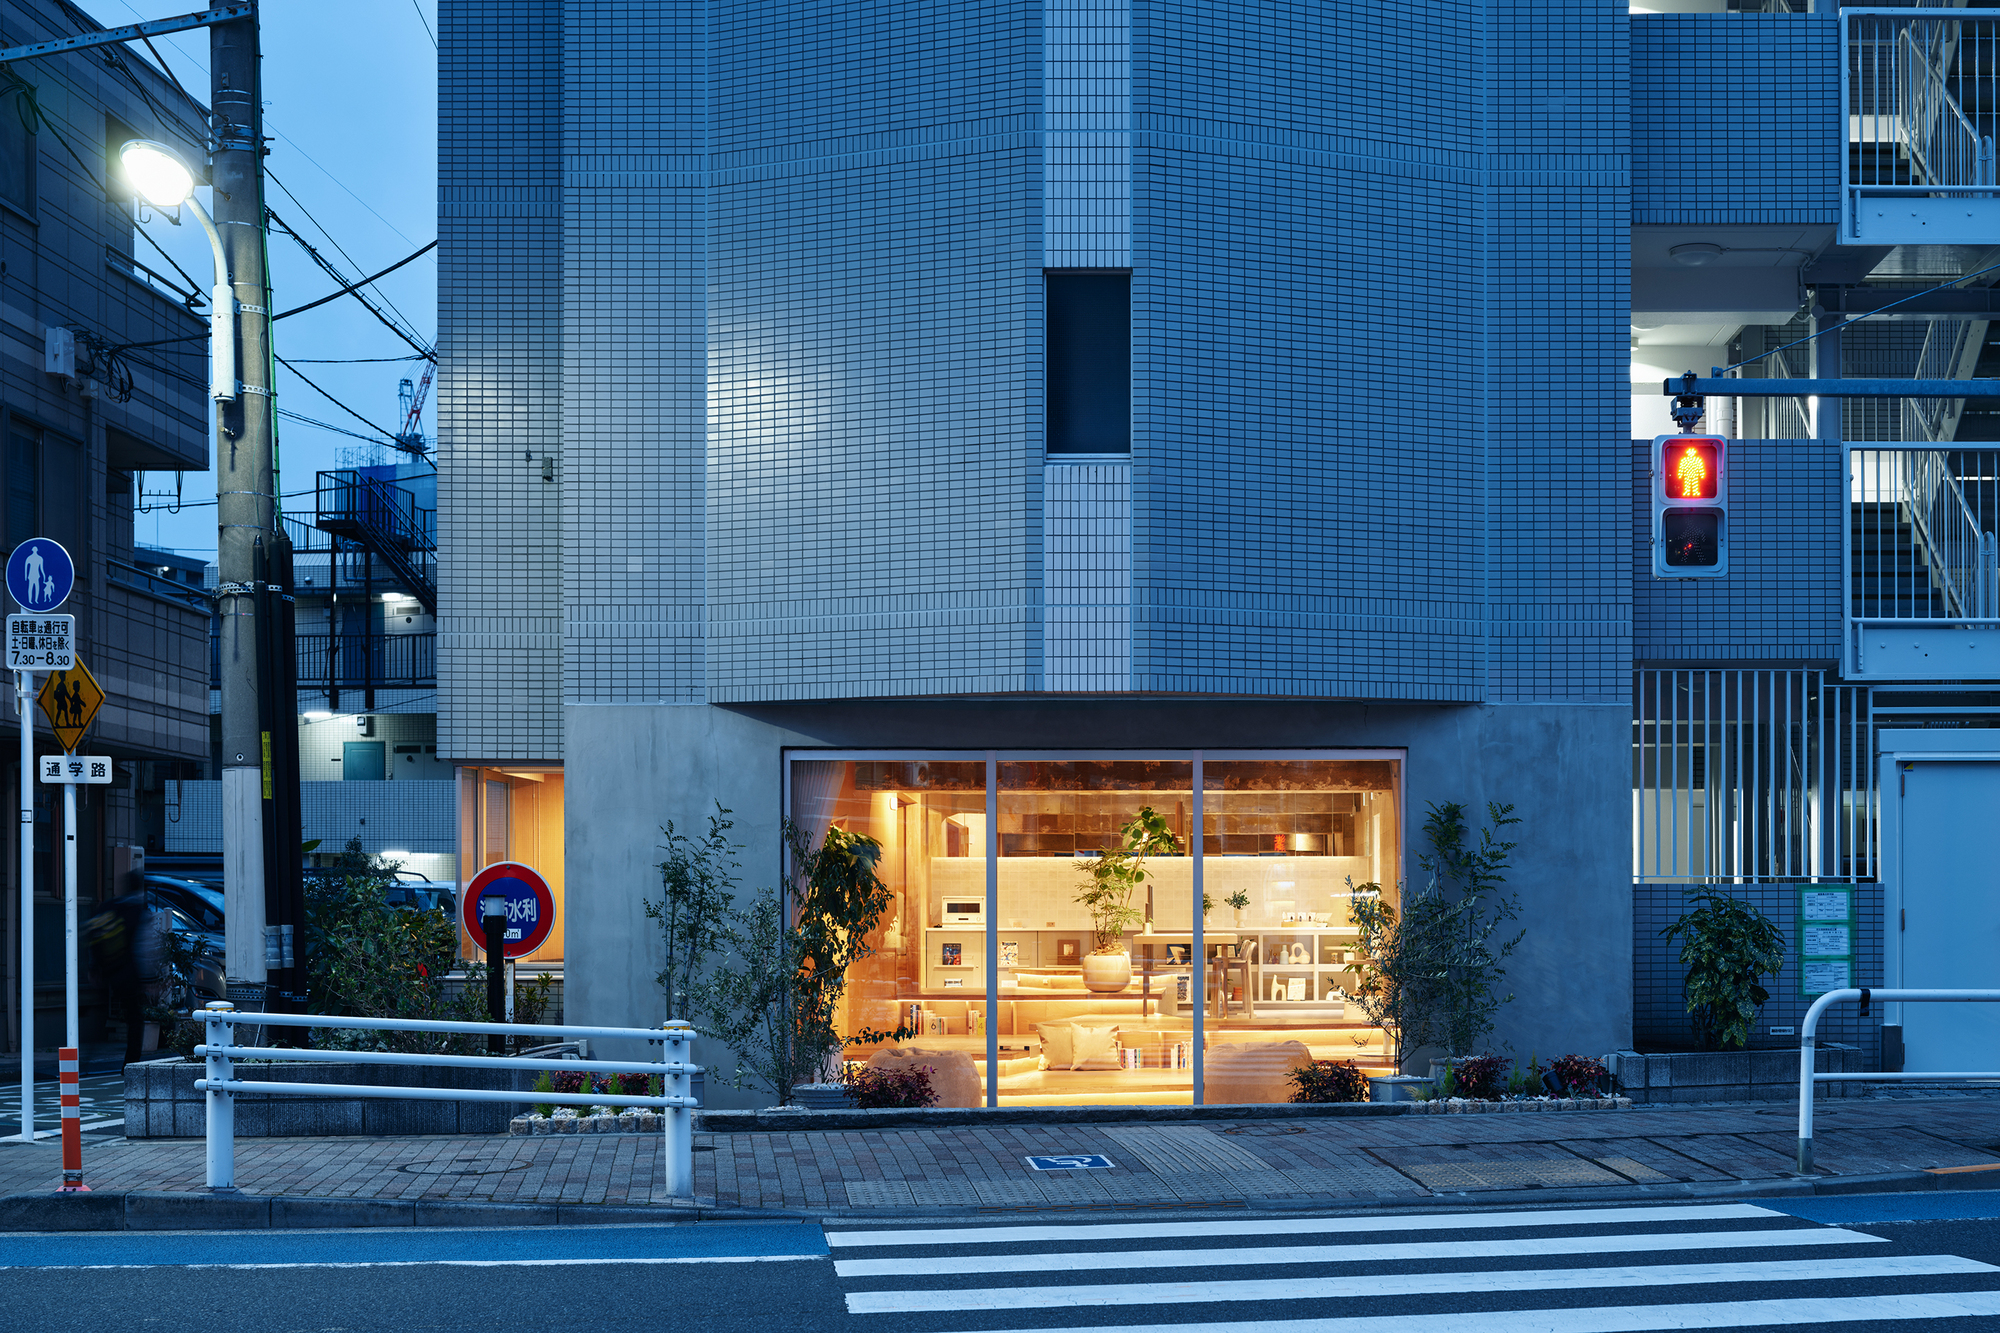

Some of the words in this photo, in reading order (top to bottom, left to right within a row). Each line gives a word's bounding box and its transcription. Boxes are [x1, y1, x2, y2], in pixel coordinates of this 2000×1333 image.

[12, 620, 69, 634] 自転車は通行可
[46, 762, 106, 777] 通学路
[480, 898, 537, 923] 水利
